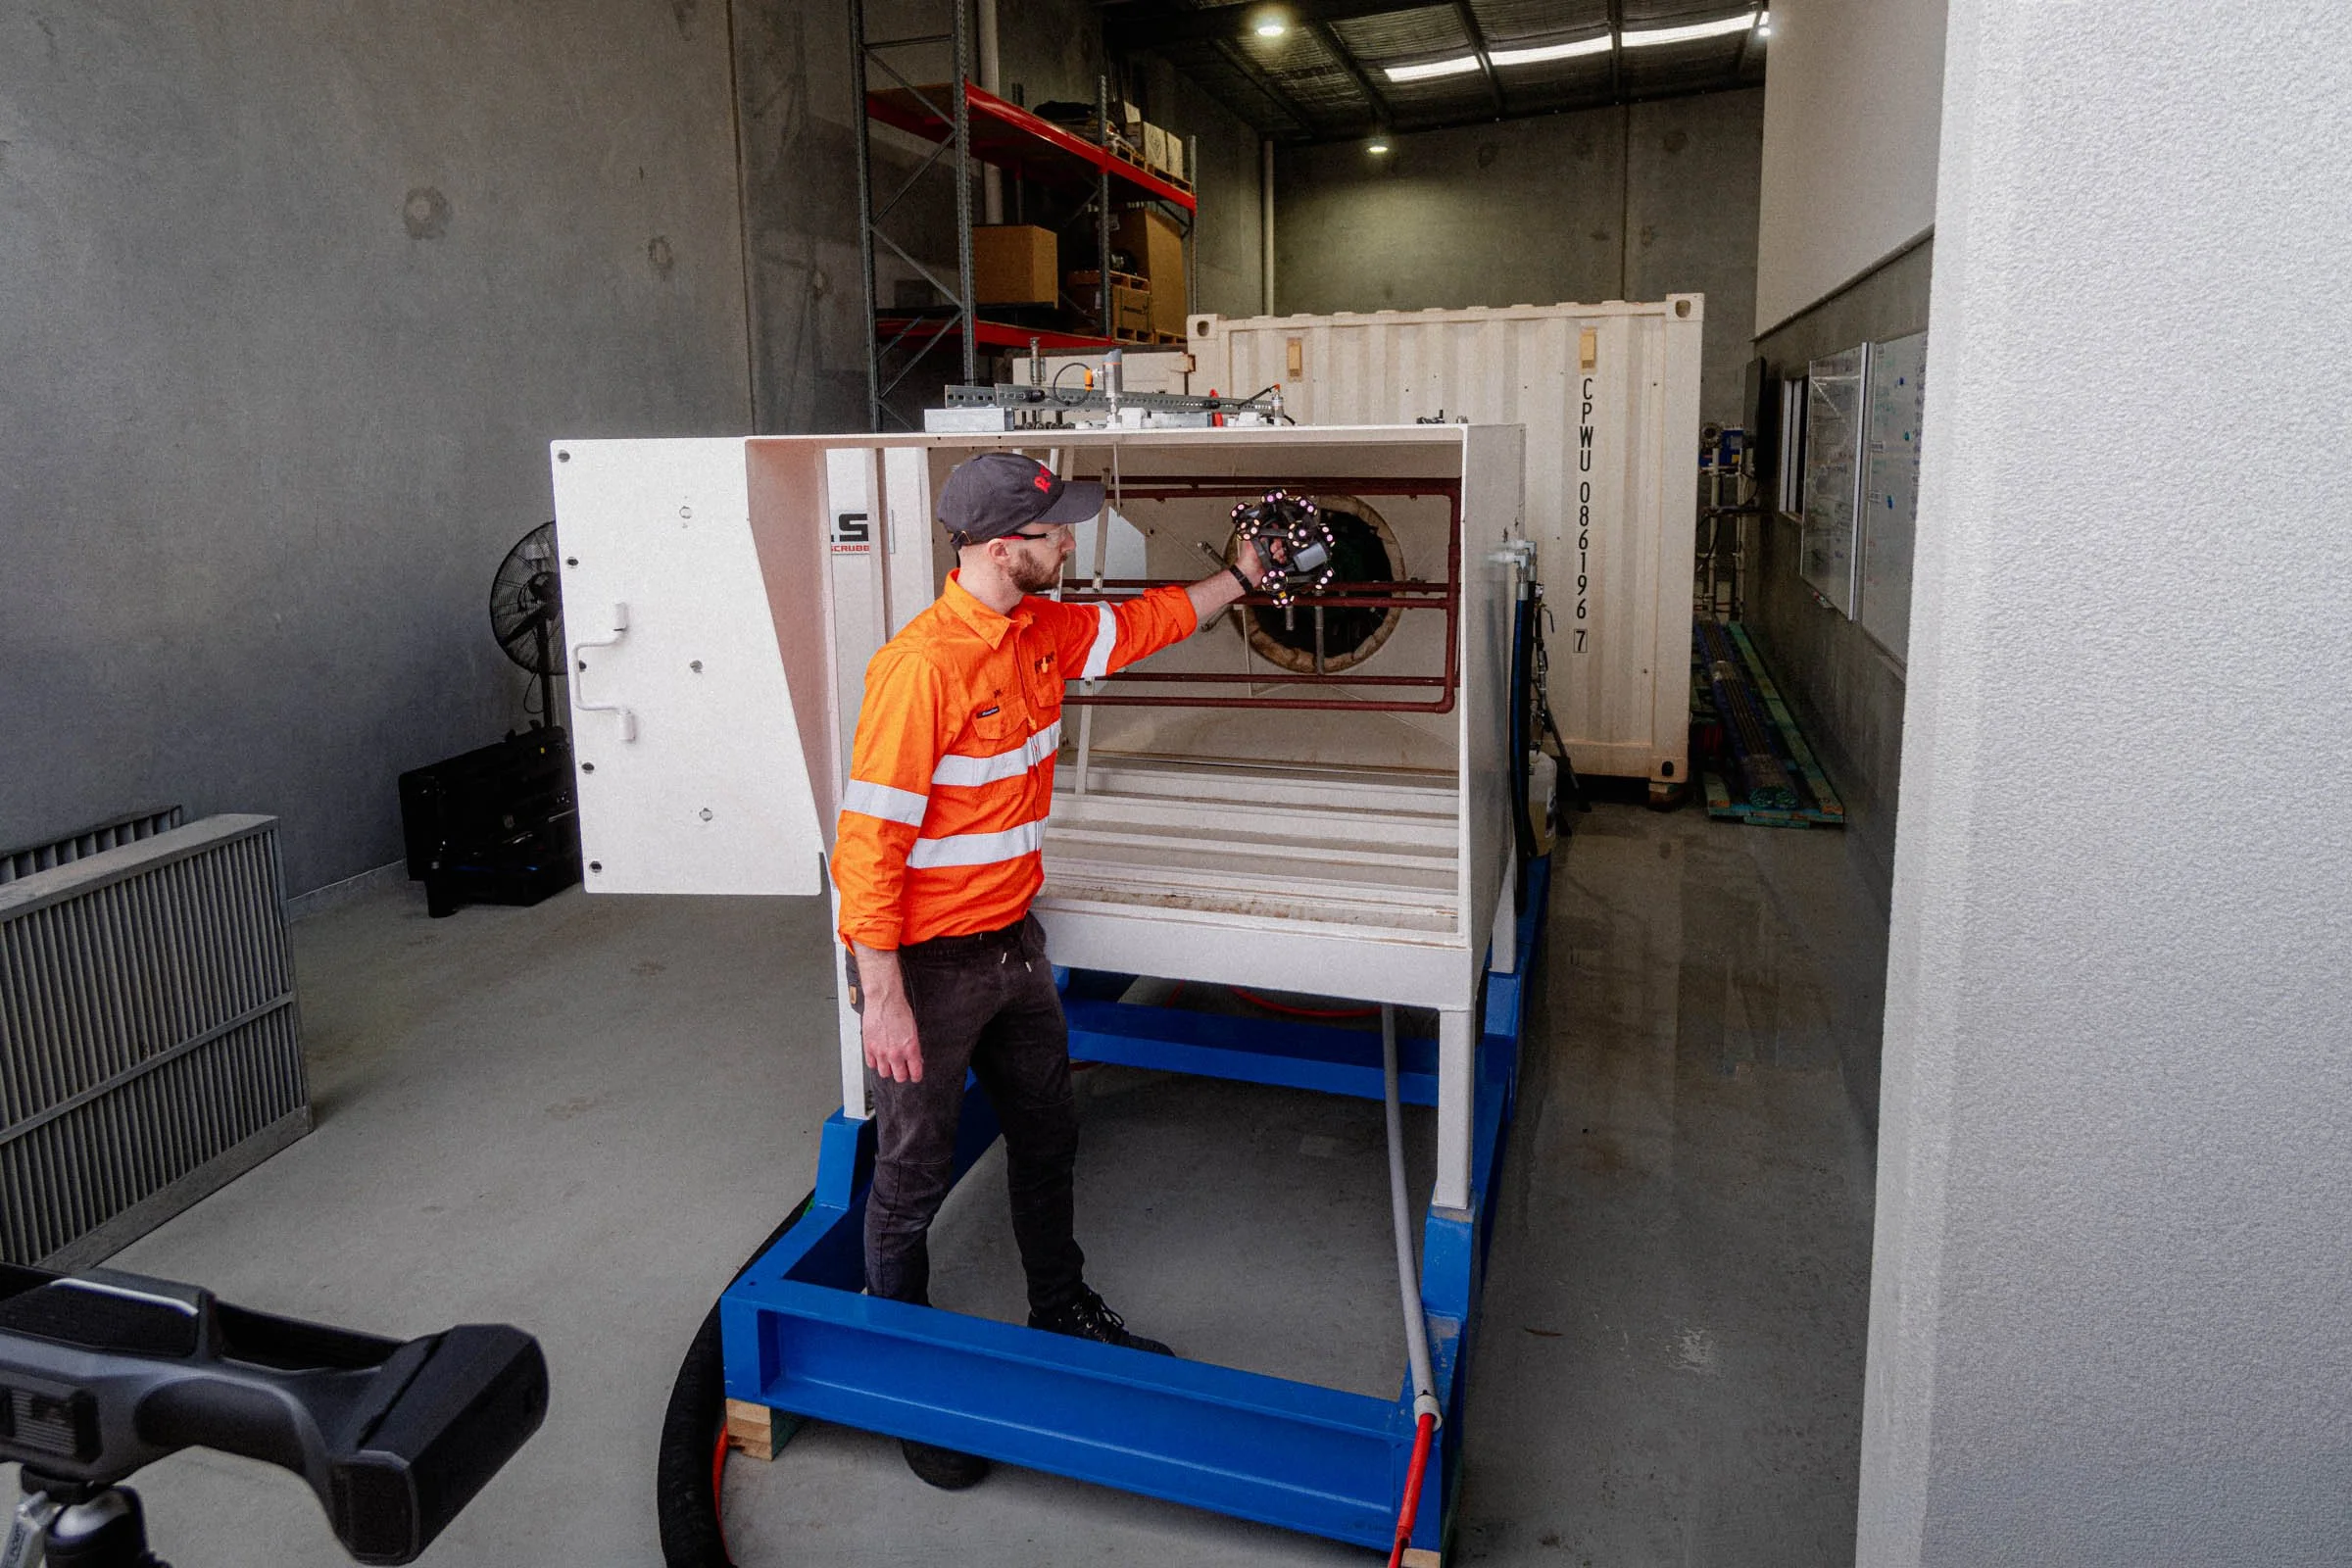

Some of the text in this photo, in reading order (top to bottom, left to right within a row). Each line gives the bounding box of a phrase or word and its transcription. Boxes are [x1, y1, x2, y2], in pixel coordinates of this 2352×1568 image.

[1576, 377, 1593, 652] CPWU 086196 7
